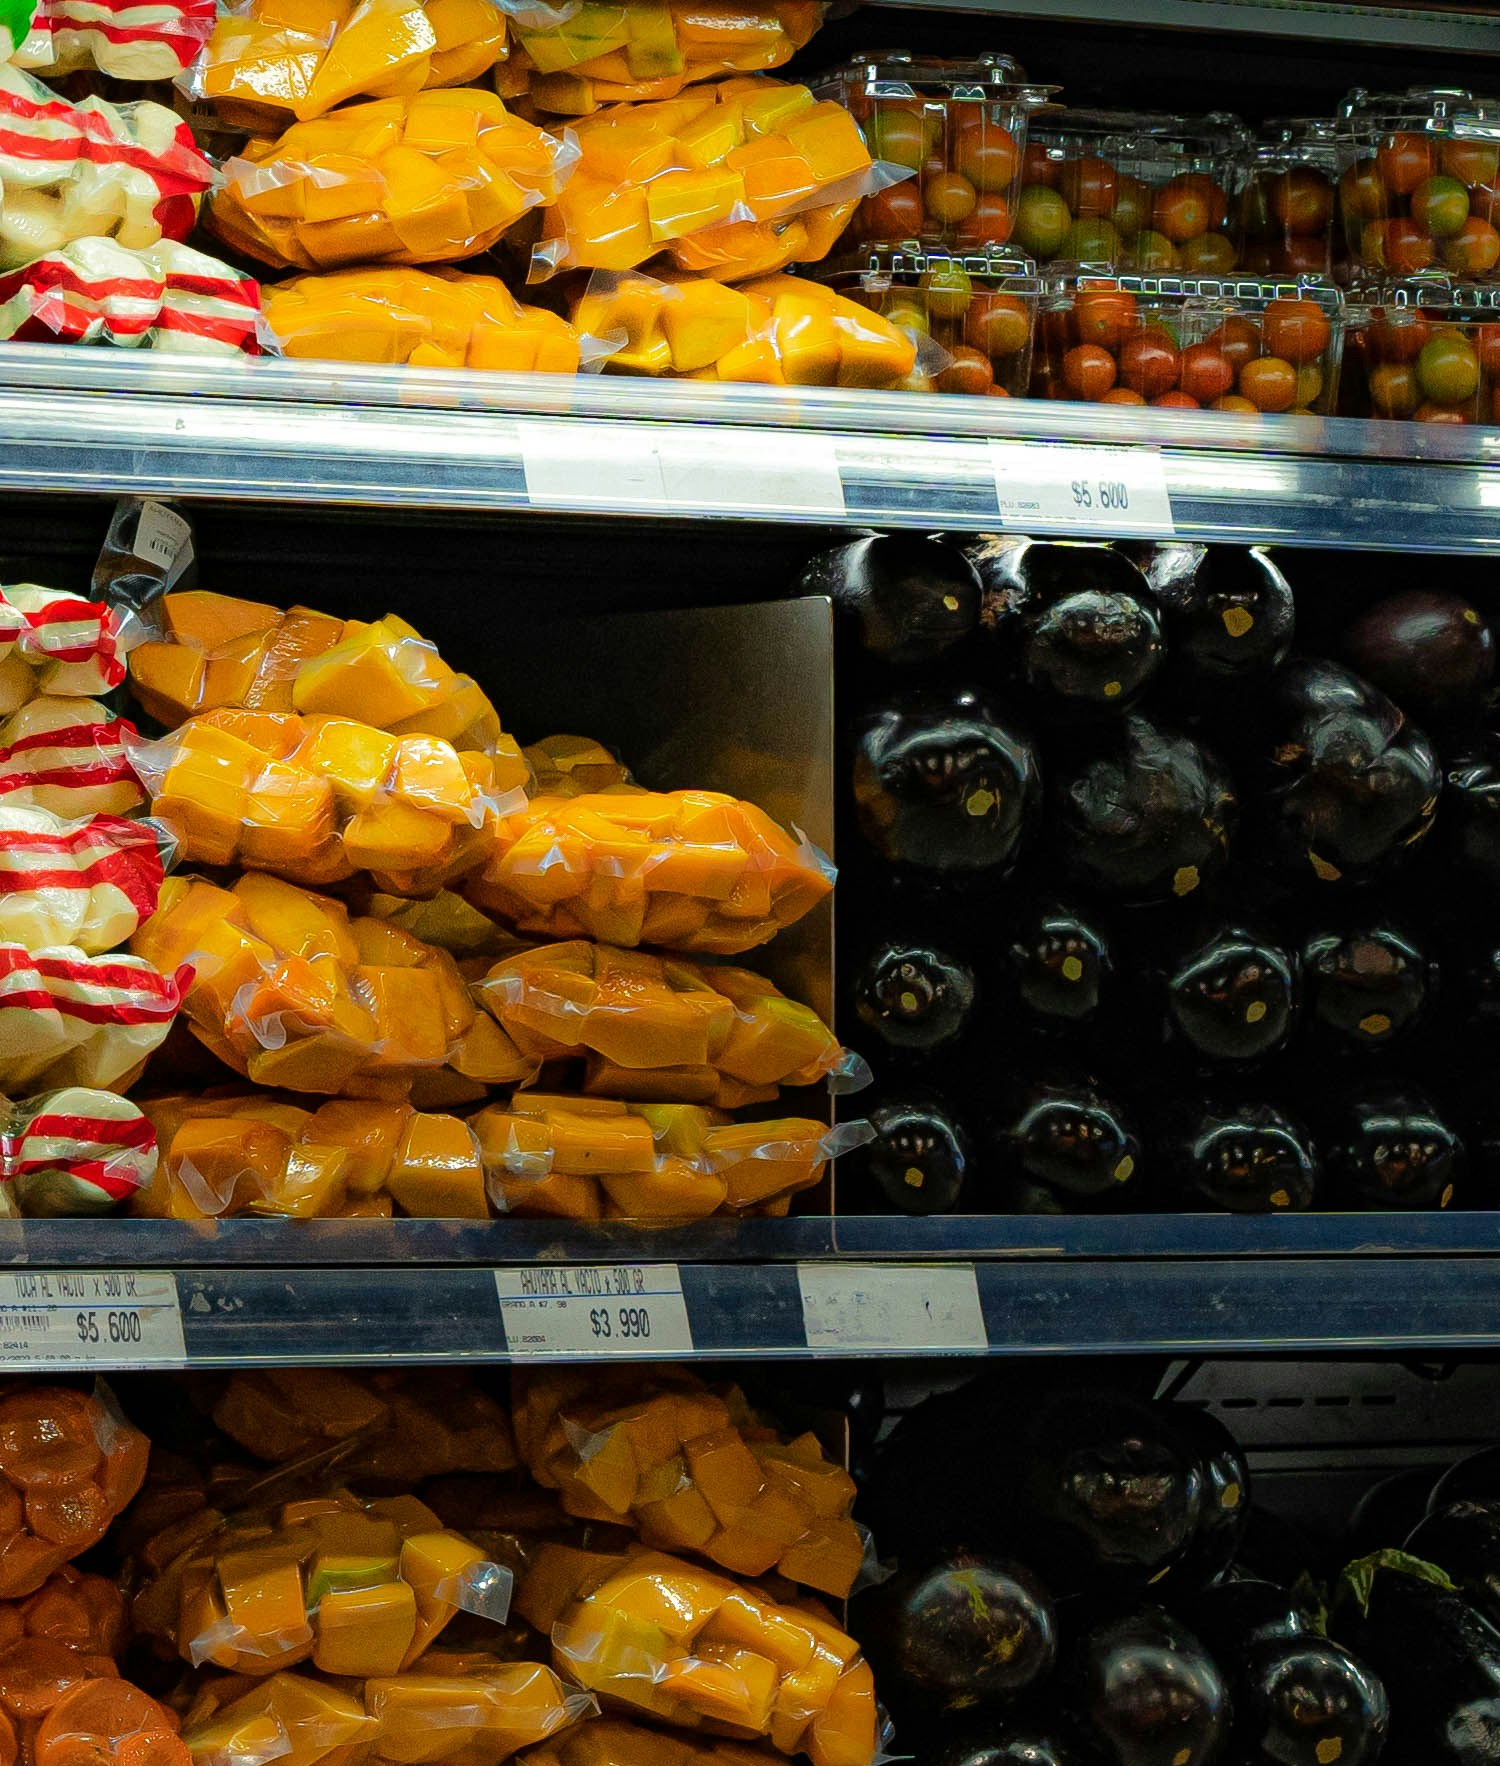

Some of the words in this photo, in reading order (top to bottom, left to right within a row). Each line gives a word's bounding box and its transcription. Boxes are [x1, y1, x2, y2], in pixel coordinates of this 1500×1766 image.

[1072, 480, 1129, 510] $5.600
[77, 1311, 142, 1344] $5.600
[590, 1308, 651, 1338] $3.990
